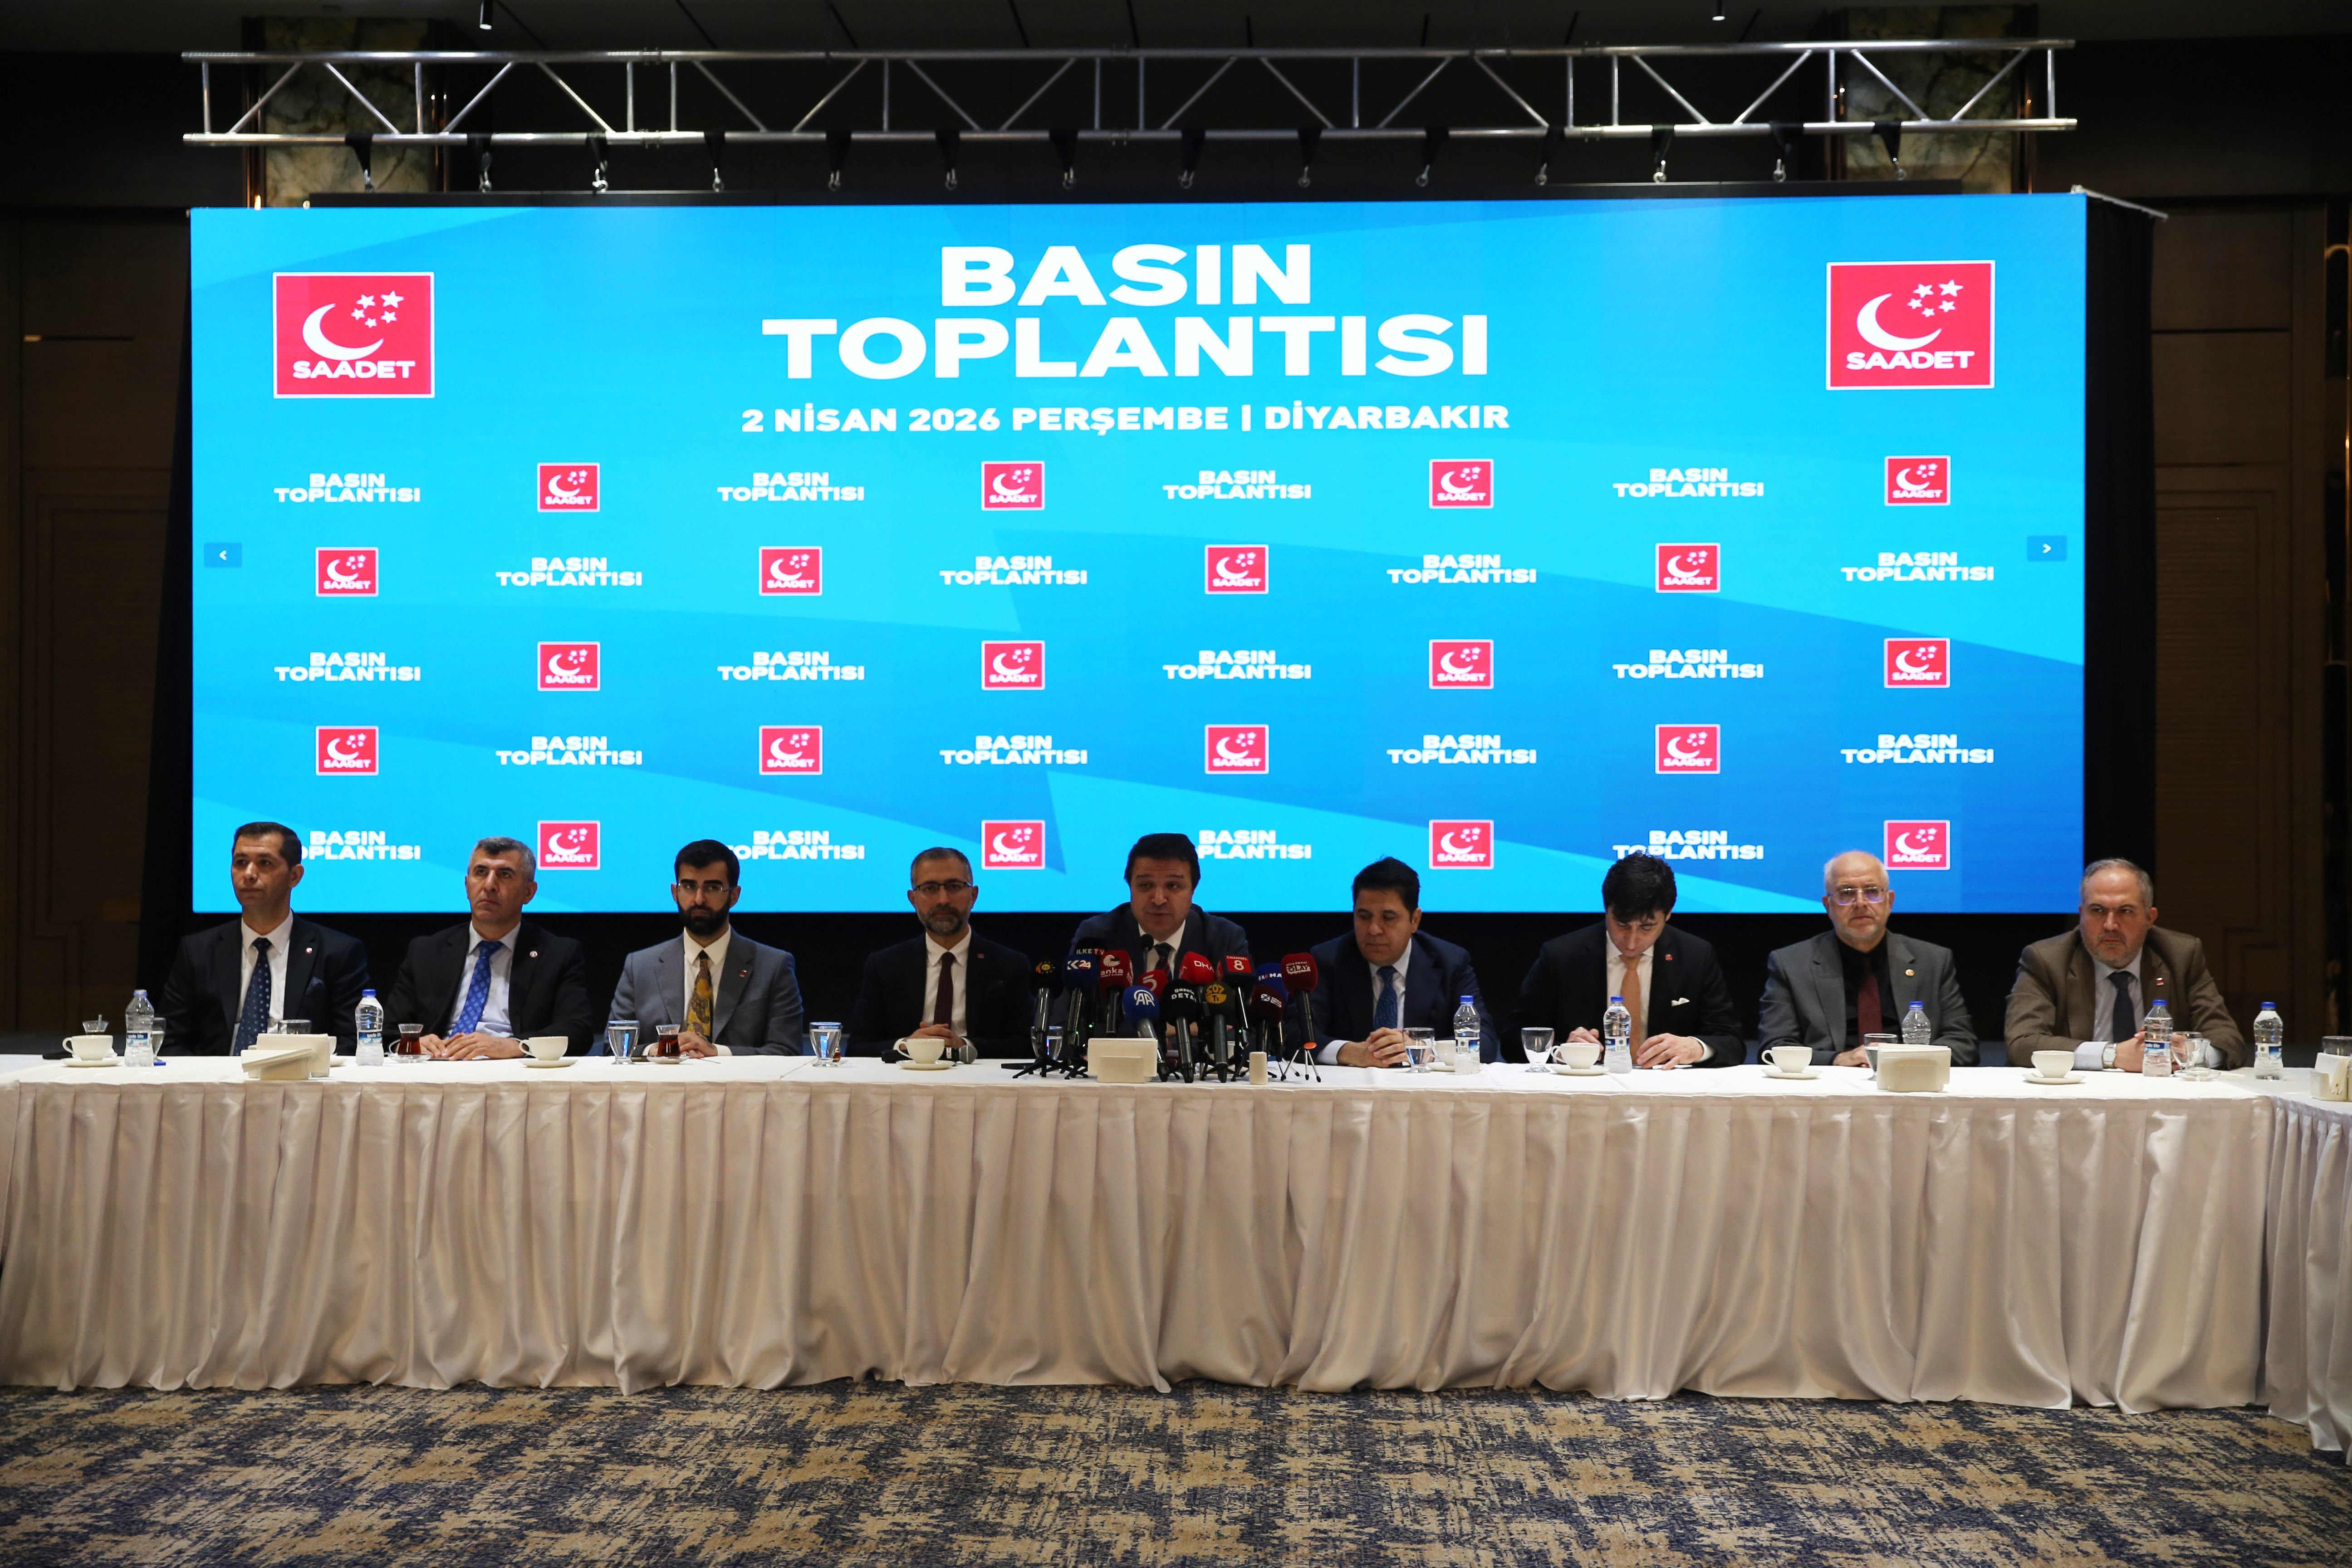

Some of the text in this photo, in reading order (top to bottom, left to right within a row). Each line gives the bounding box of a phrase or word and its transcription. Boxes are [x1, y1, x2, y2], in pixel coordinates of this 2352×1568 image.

[941, 244, 1311, 306] BASIN
[762, 314, 1487, 380] TOPLANTISI
[1846, 351, 1975, 370] SAADET
[293, 361, 416, 379] SAADET
[742, 409, 764, 432] 2
[775, 403, 897, 432] NİSAN
[909, 408, 1000, 431] 2026
[1013, 407, 1228, 436] PERŞEMBE
[1265, 400, 1510, 429] DİYARBAKIR
[309, 473, 385, 488] BASIN
[753, 472, 829, 487] BASIN
[1199, 470, 1276, 485] BASIN
[1650, 468, 1728, 483] BASIN
[274, 488, 421, 503] TOPLANTISI
[717, 486, 864, 501] TOPLANTISI
[1162, 485, 1311, 500] TOPLANTISI
[1437, 492, 1486, 501] SAADET
[1612, 483, 1764, 498] TOPLANTISI
[1892, 489, 1943, 499] SAADET
[545, 495, 593, 505] SAADET
[989, 494, 1038, 504] SAADET
[531, 557, 607, 572] BASIN
[975, 556, 1052, 571] BASIN
[1423, 554, 1501, 569] BASIN
[1878, 552, 1958, 567] BASIN
[495, 572, 642, 586] TOPLANTISI
[939, 570, 1088, 585] TOPLANTISI
[1387, 568, 1537, 583] TOPLANTISI
[1663, 576, 1713, 586] SAADET
[1841, 567, 1994, 582] TOPLANTISI
[323, 580, 371, 589] SAADET
[766, 579, 815, 588] SAADET
[1212, 578, 1261, 587] SAADET
[310, 652, 386, 667] BASIN
[753, 651, 829, 666] BASIN
[1199, 650, 1276, 665] BASIN
[1649, 649, 1727, 664] BASIN
[274, 666, 421, 681] TOPLANTISI
[717, 666, 865, 681] TOPLANTISI
[989, 674, 1038, 683] SAADET
[1162, 665, 1311, 679] TOPLANTISI
[1437, 673, 1486, 682] SAADET
[1612, 664, 1764, 679] TOPLANTISI
[1892, 671, 1942, 681] SAADET
[545, 675, 593, 684] SAADET
[532, 736, 608, 751] BASIN
[975, 735, 1052, 750] BASIN
[1423, 735, 1501, 750] BASIN
[1878, 734, 1957, 749] BASIN
[323, 759, 371, 768] SAADET
[495, 750, 642, 765] TOPLANTISI
[766, 759, 815, 768] SAADET
[940, 750, 1088, 764] TOPLANTISI
[1212, 758, 1261, 767] SAADET
[1387, 749, 1537, 764] TOPLANTISI
[1663, 757, 1713, 767] SAADET
[1841, 749, 1994, 764] TOPLANTISI
[309, 831, 386, 846] BASIN
[753, 830, 829, 845] BASIN
[1199, 830, 1276, 845] BASIN
[1649, 830, 1727, 845] BASIN
[301, 845, 421, 860] PLANTISI
[545, 853, 593, 863] SAADET
[989, 853, 1038, 862] SAADET
[1196, 844, 1312, 859] PLANTISI
[1437, 853, 1486, 862] SAADET
[1891, 853, 1942, 862] SAADET
[1100, 967, 1123, 976] anka
[1194, 960, 1215, 975] DHA
[1234, 960, 1245, 970] 8
[1142, 974, 1157, 991] 5
[1135, 992, 1155, 1006] AA
